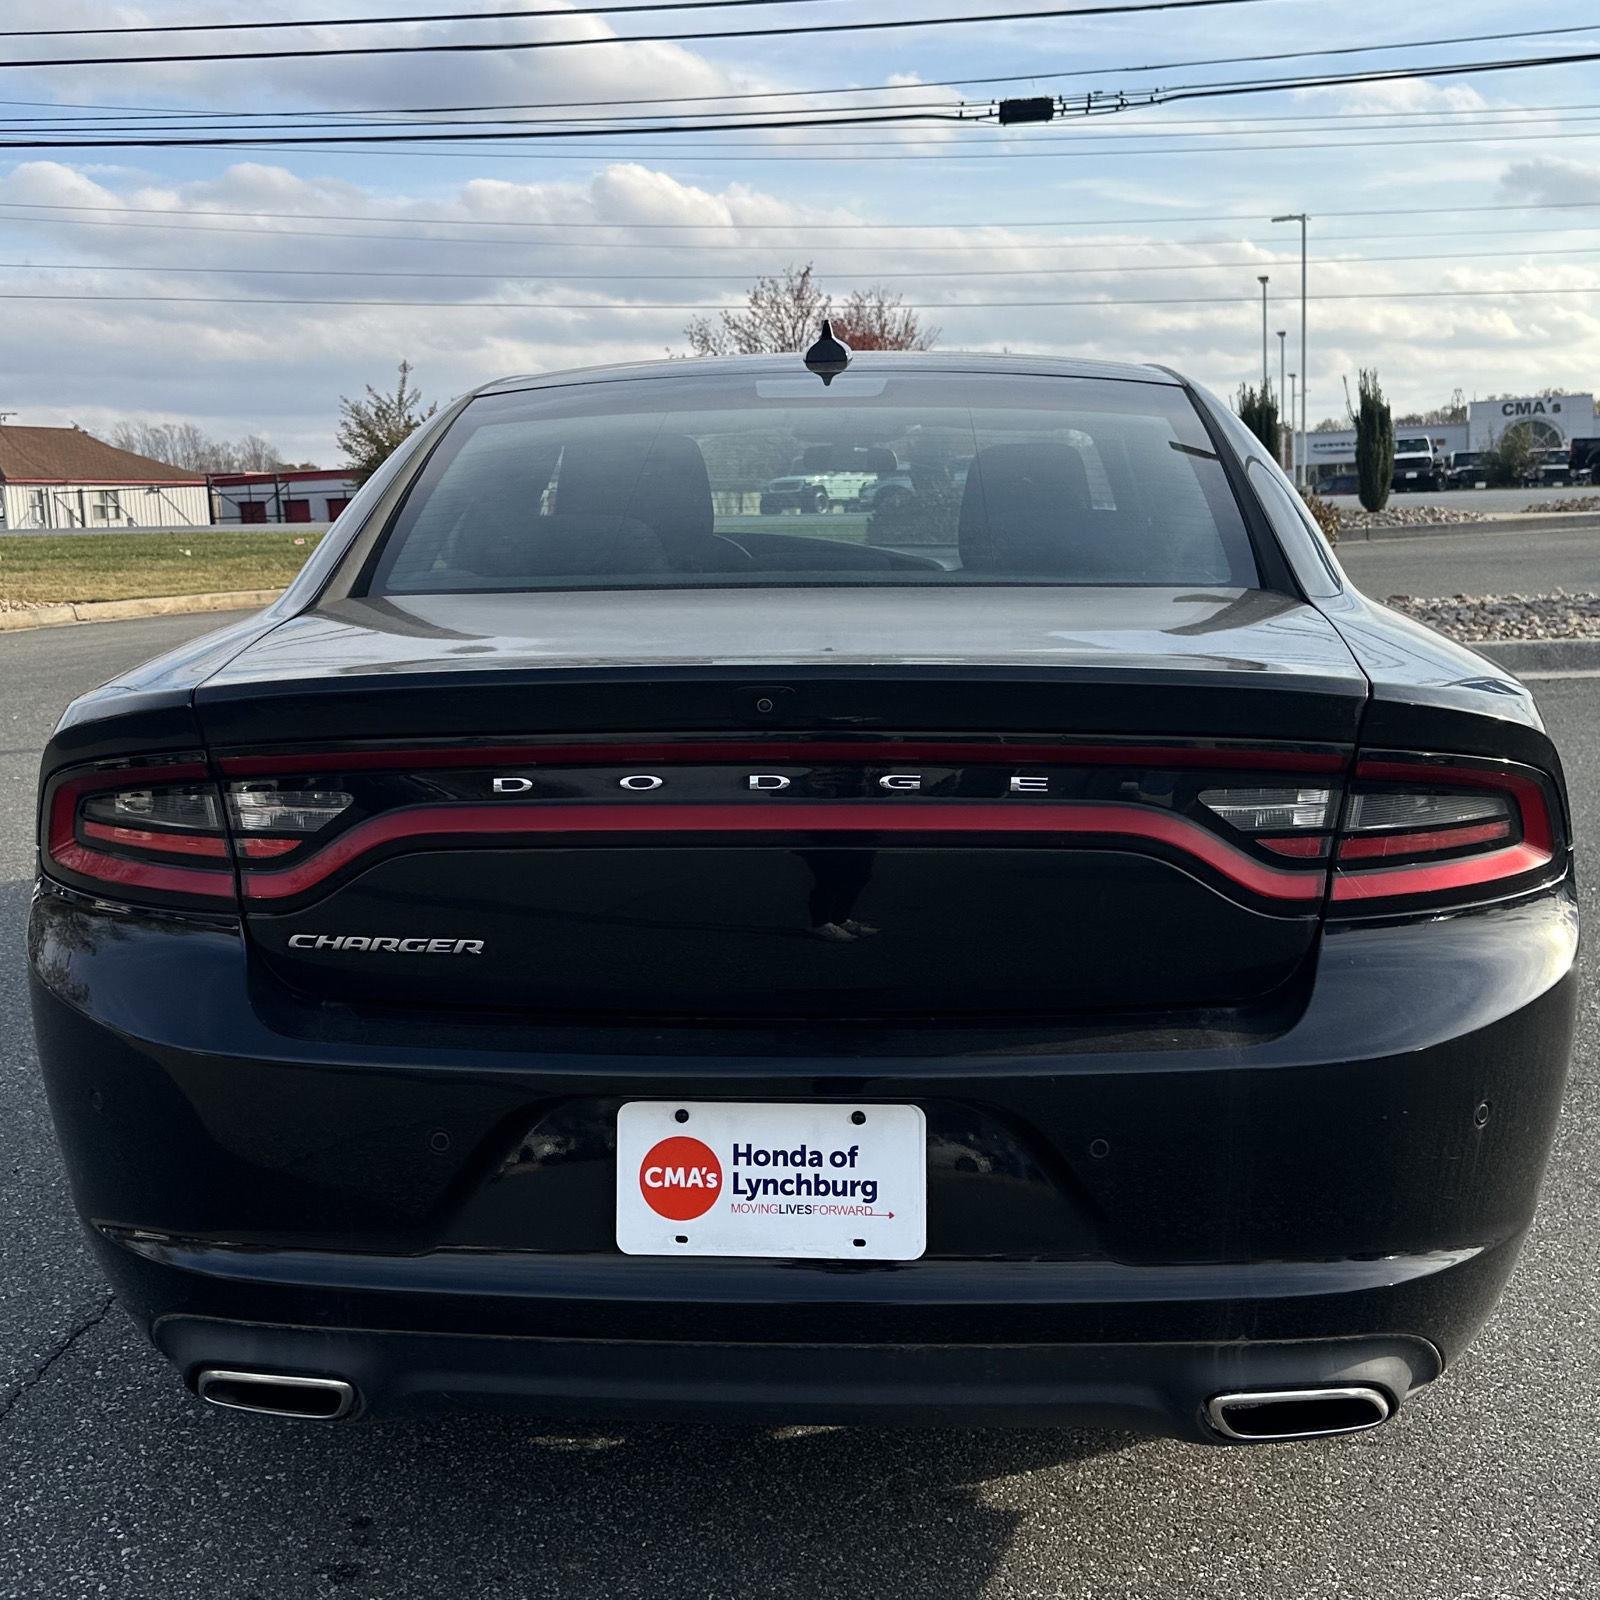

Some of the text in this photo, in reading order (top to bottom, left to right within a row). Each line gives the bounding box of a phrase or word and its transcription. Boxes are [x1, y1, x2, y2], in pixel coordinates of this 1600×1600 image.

[1502, 398, 1561, 417] CMA's
[492, 774, 1048, 793] DODGE
[287, 934, 484, 955] CHARGER
[733, 1143, 859, 1168] Honda of
[645, 1166, 718, 1189] CMA's
[733, 1172, 878, 1203] Lynchburg
